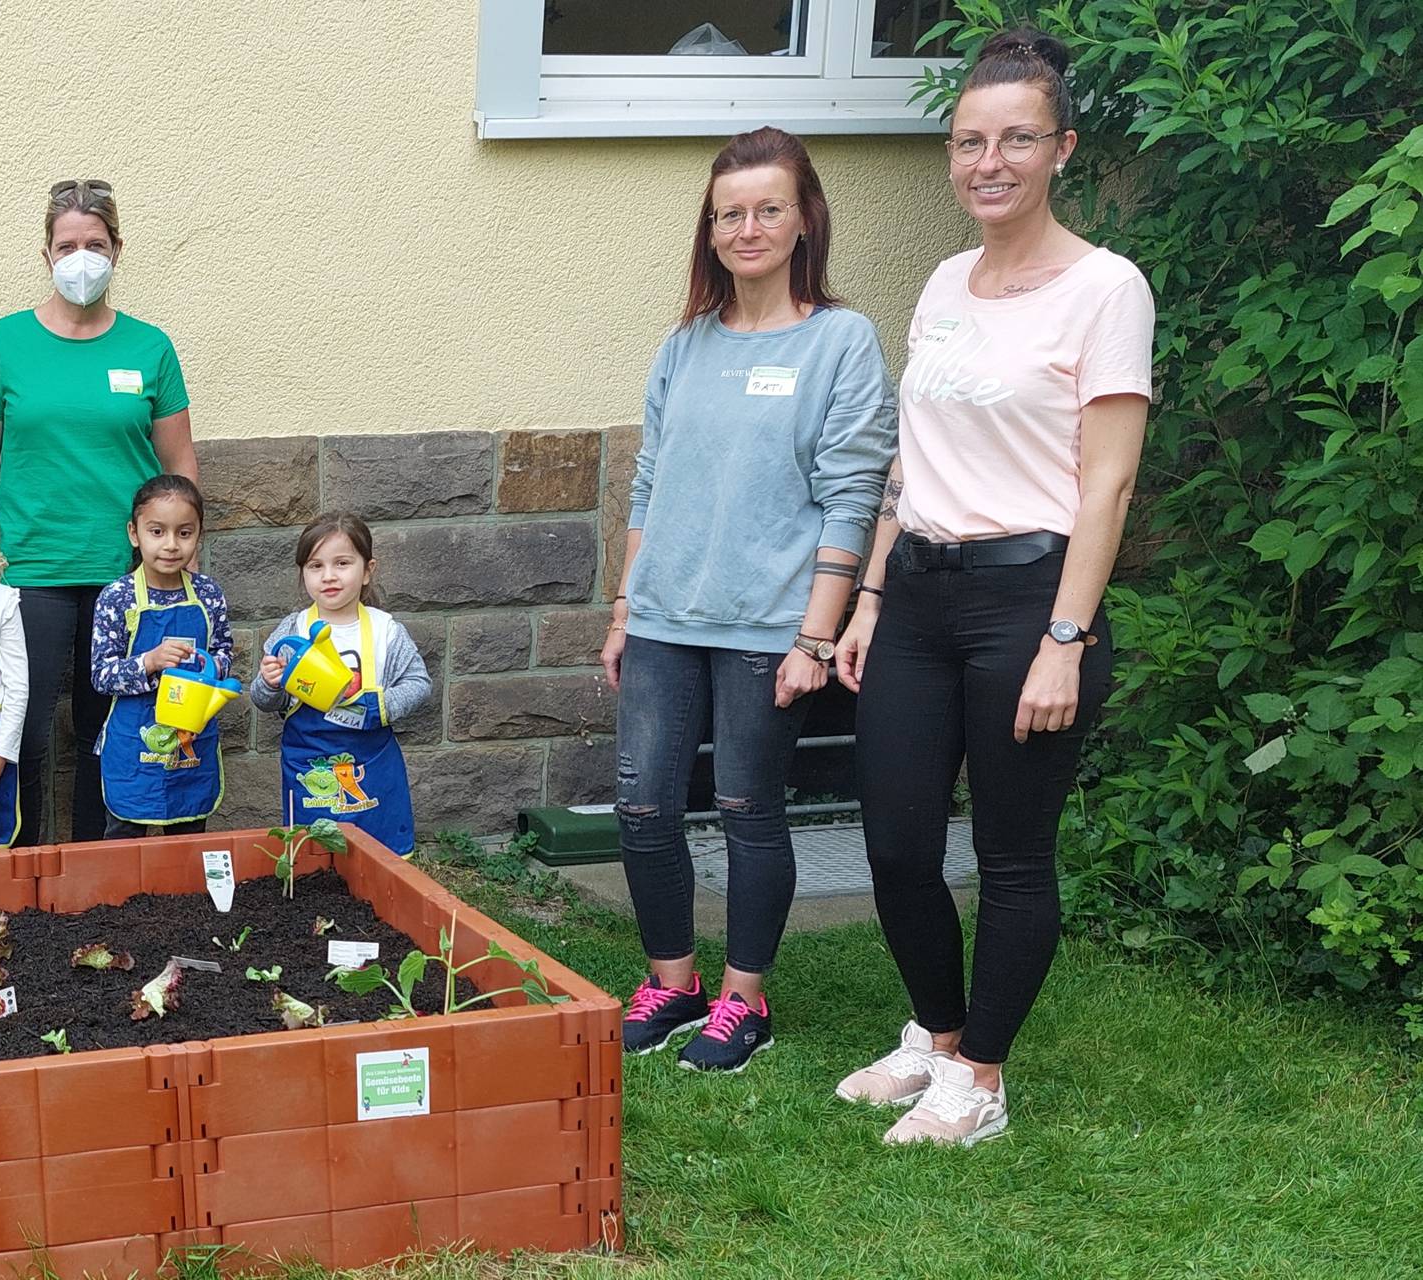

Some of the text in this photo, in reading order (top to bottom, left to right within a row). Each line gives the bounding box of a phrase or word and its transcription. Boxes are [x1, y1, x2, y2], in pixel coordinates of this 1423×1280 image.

[365, 1074, 422, 1087] Gemüsebeete
[376, 1085, 410, 1096] für Kids
